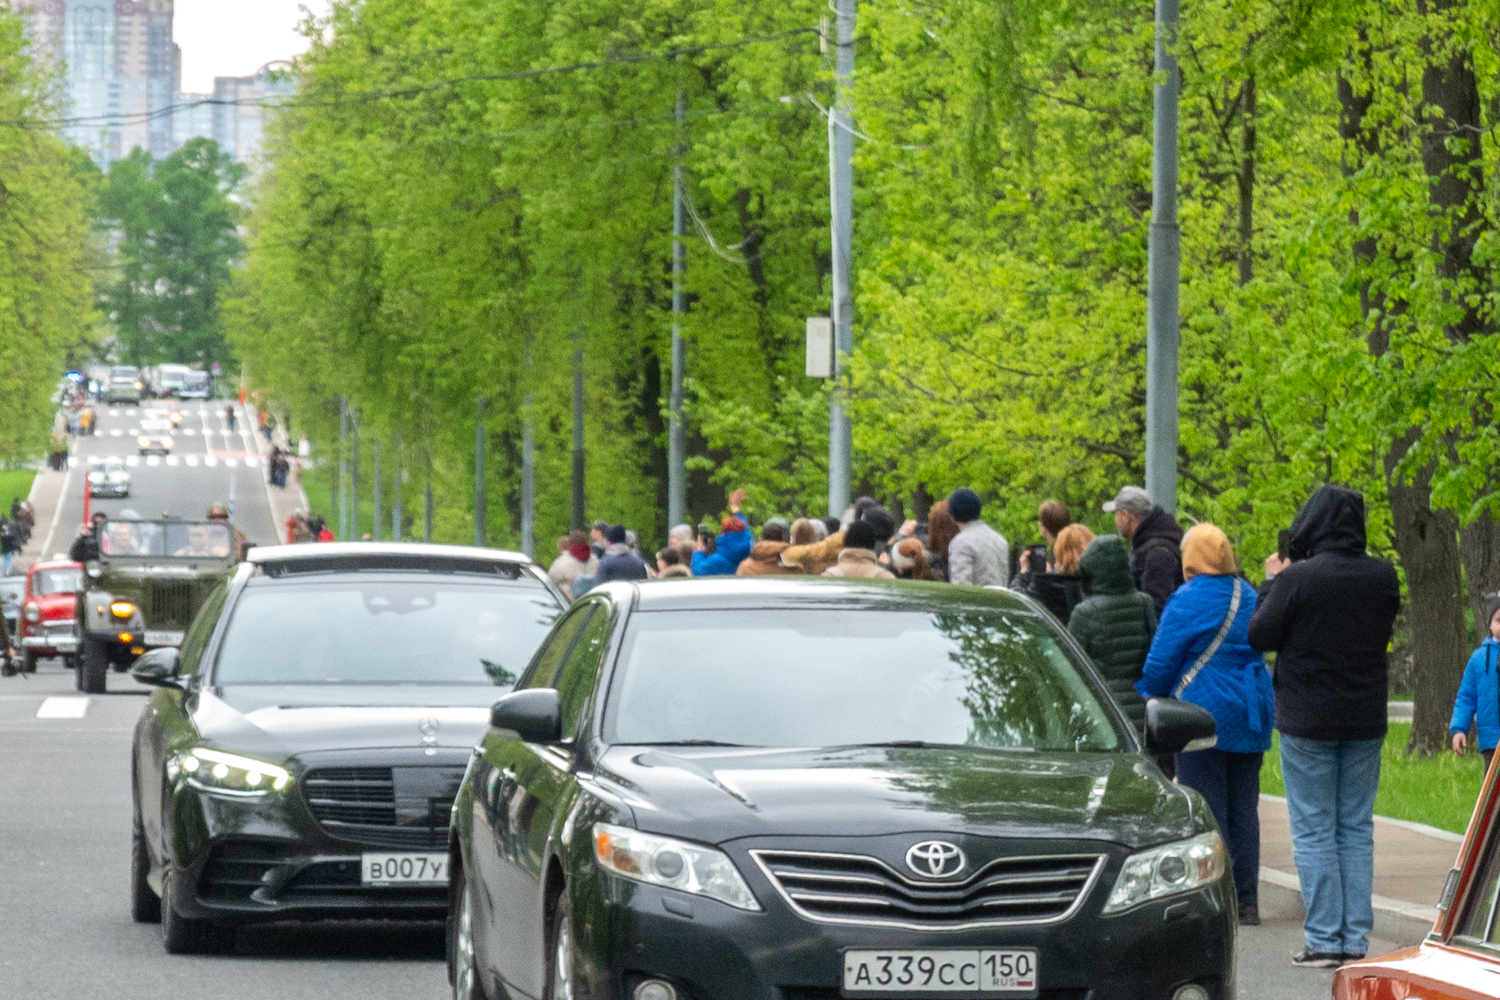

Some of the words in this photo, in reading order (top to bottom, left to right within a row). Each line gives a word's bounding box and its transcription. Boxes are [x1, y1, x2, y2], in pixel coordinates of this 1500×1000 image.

[854, 955, 977, 986] А339СС
[984, 954, 1030, 977] 150
[992, 977, 1016, 987] RUS
